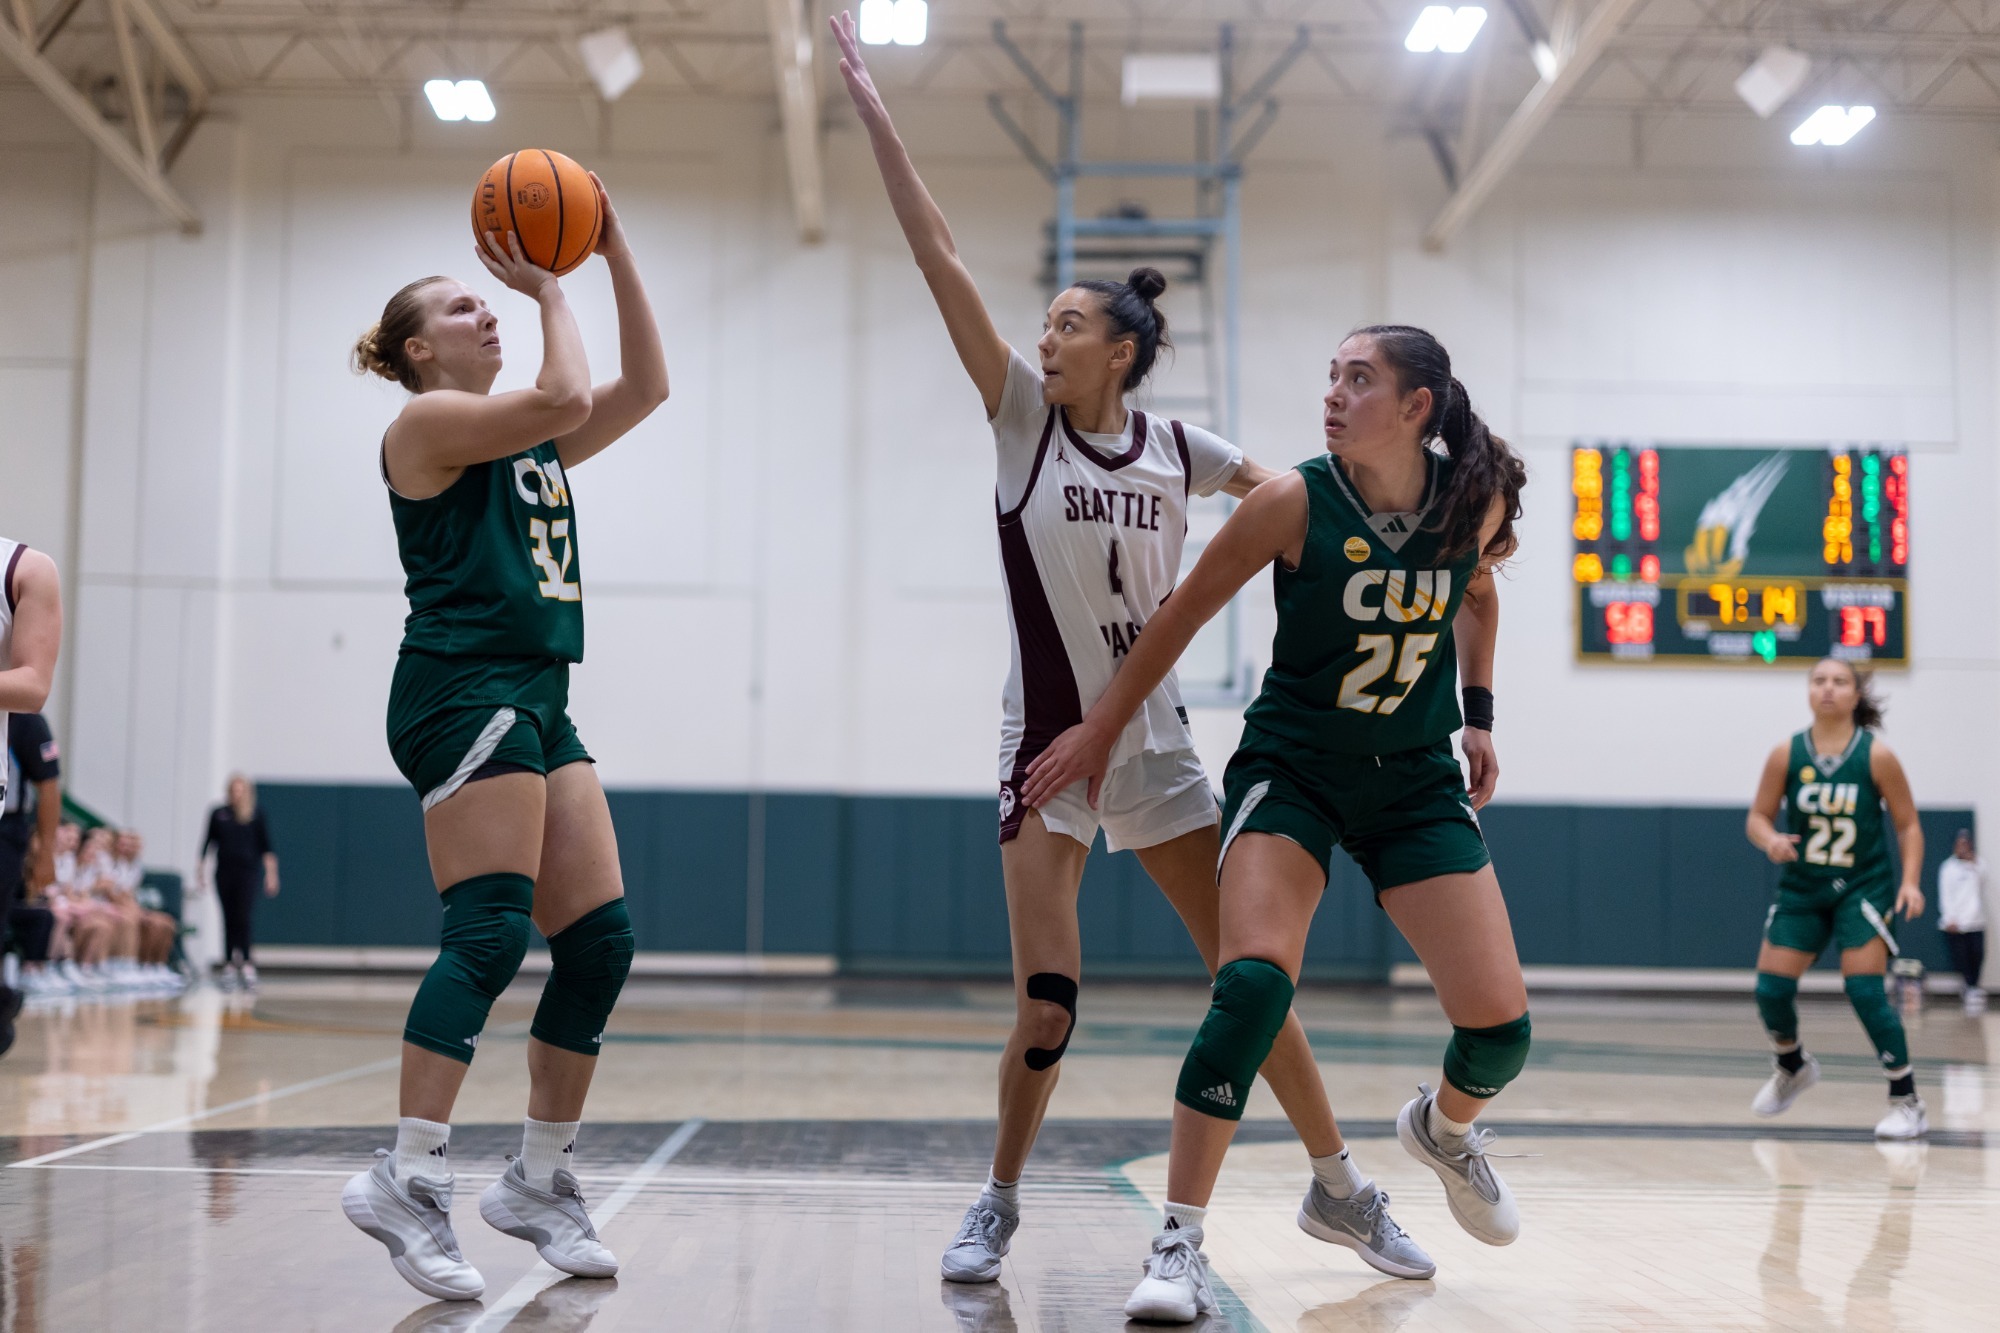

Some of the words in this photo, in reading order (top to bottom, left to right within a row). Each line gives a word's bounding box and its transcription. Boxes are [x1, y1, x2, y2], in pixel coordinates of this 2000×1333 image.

[1063, 485, 1161, 532] SEATTLE
[530, 517, 581, 601] 32
[1343, 569, 1451, 622] CUI
[1336, 632, 1439, 715] 25
[1796, 782, 1859, 815] CUI
[1805, 815, 1857, 868] 22
[1201, 1089, 1237, 1107] adidas
